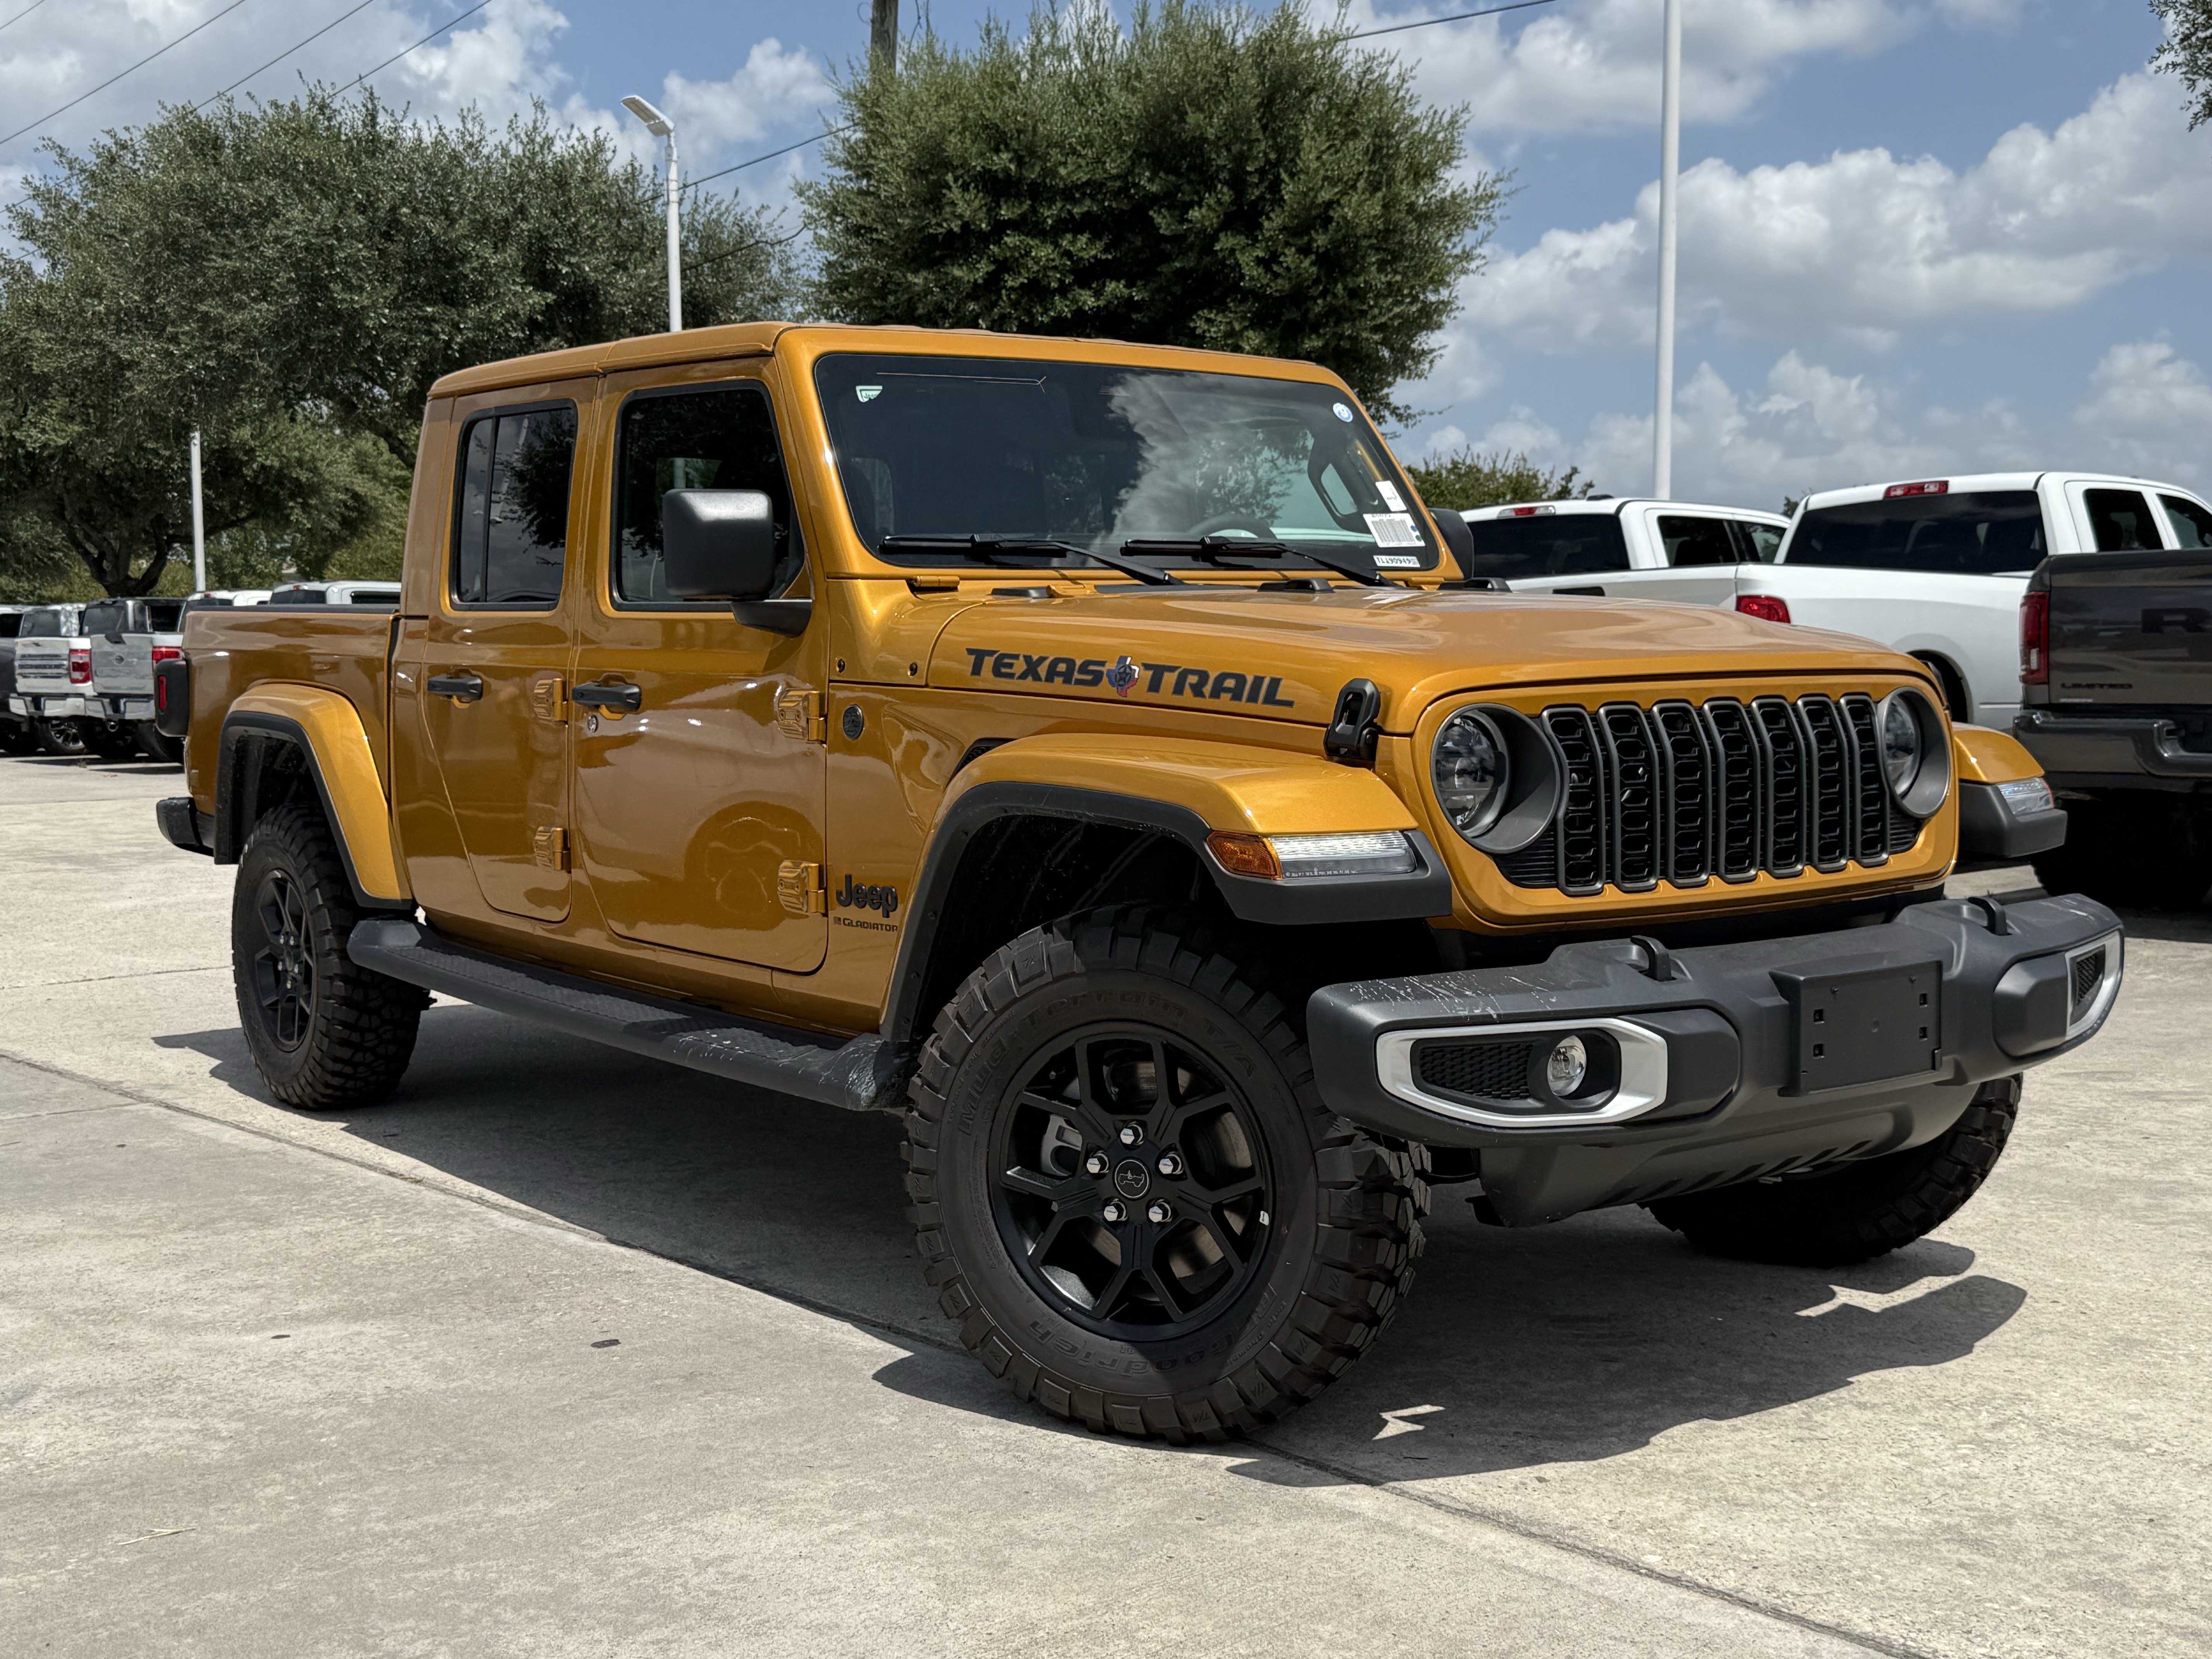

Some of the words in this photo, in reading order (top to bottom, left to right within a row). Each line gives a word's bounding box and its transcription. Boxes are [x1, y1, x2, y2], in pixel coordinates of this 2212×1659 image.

[966, 647, 1108, 687] TEXAS
[1140, 662, 1295, 708] TRAIL
[836, 874, 898, 919] Jeep
[842, 918, 898, 933] GLADIATOR
